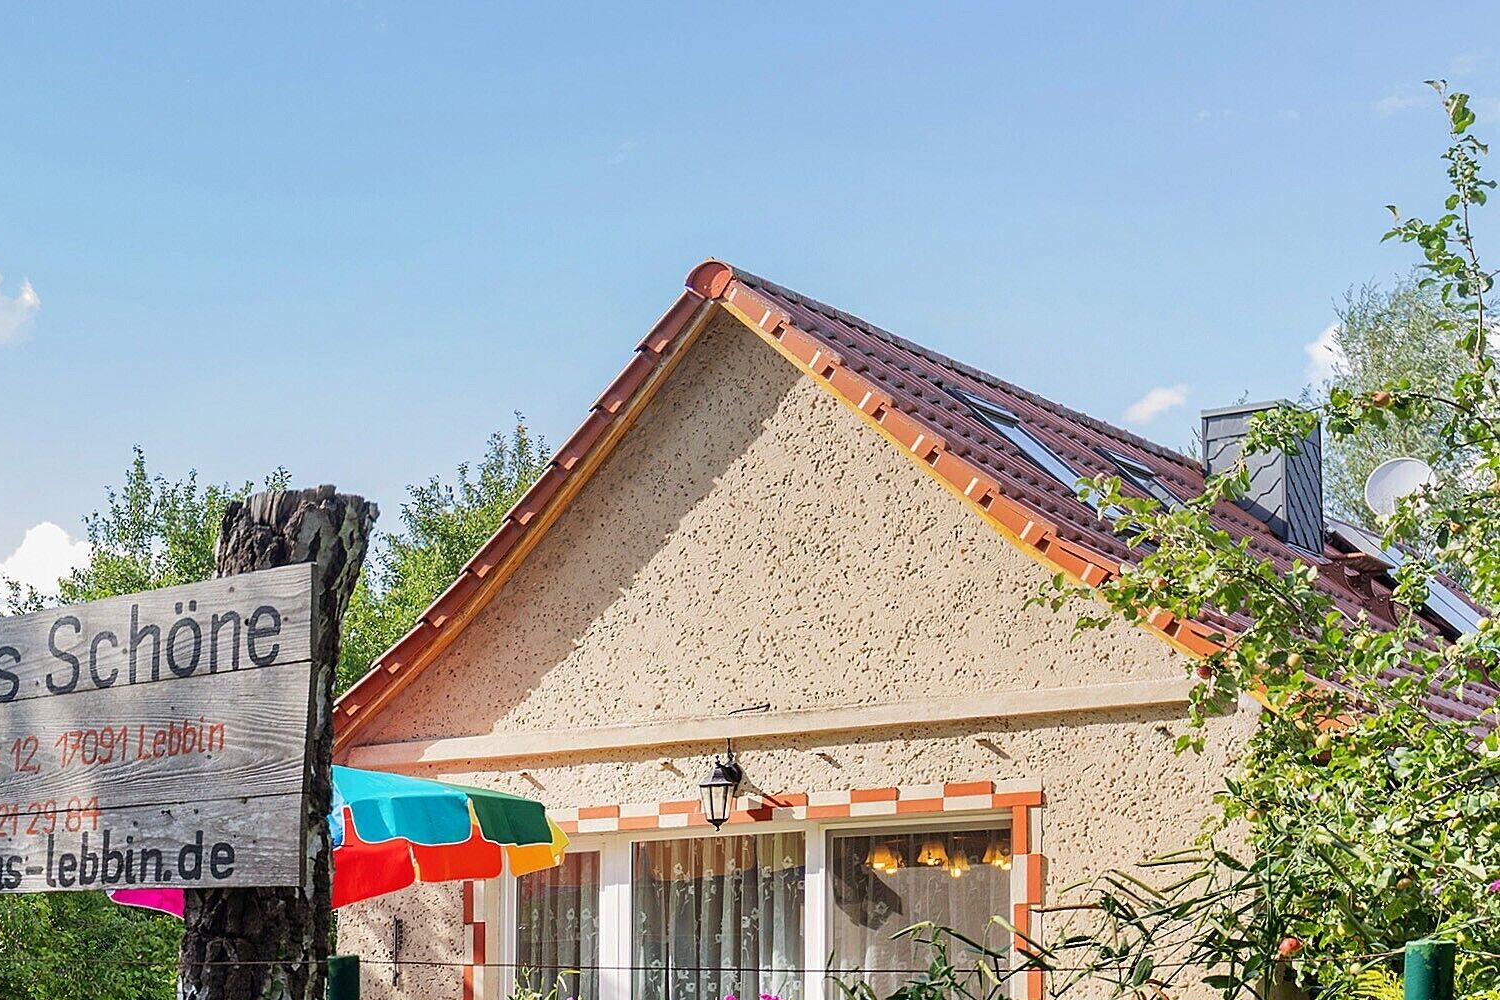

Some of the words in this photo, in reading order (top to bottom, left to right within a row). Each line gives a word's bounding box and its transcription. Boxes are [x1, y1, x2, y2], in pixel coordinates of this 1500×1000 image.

[46, 600, 282, 695] Schöne
[11, 735, 40, 774] 12,
[54, 725, 128, 768] 17091
[137, 716, 225, 760] Lebbin
[26, 799, 57, 835] 29
[65, 795, 102, 833] 84
